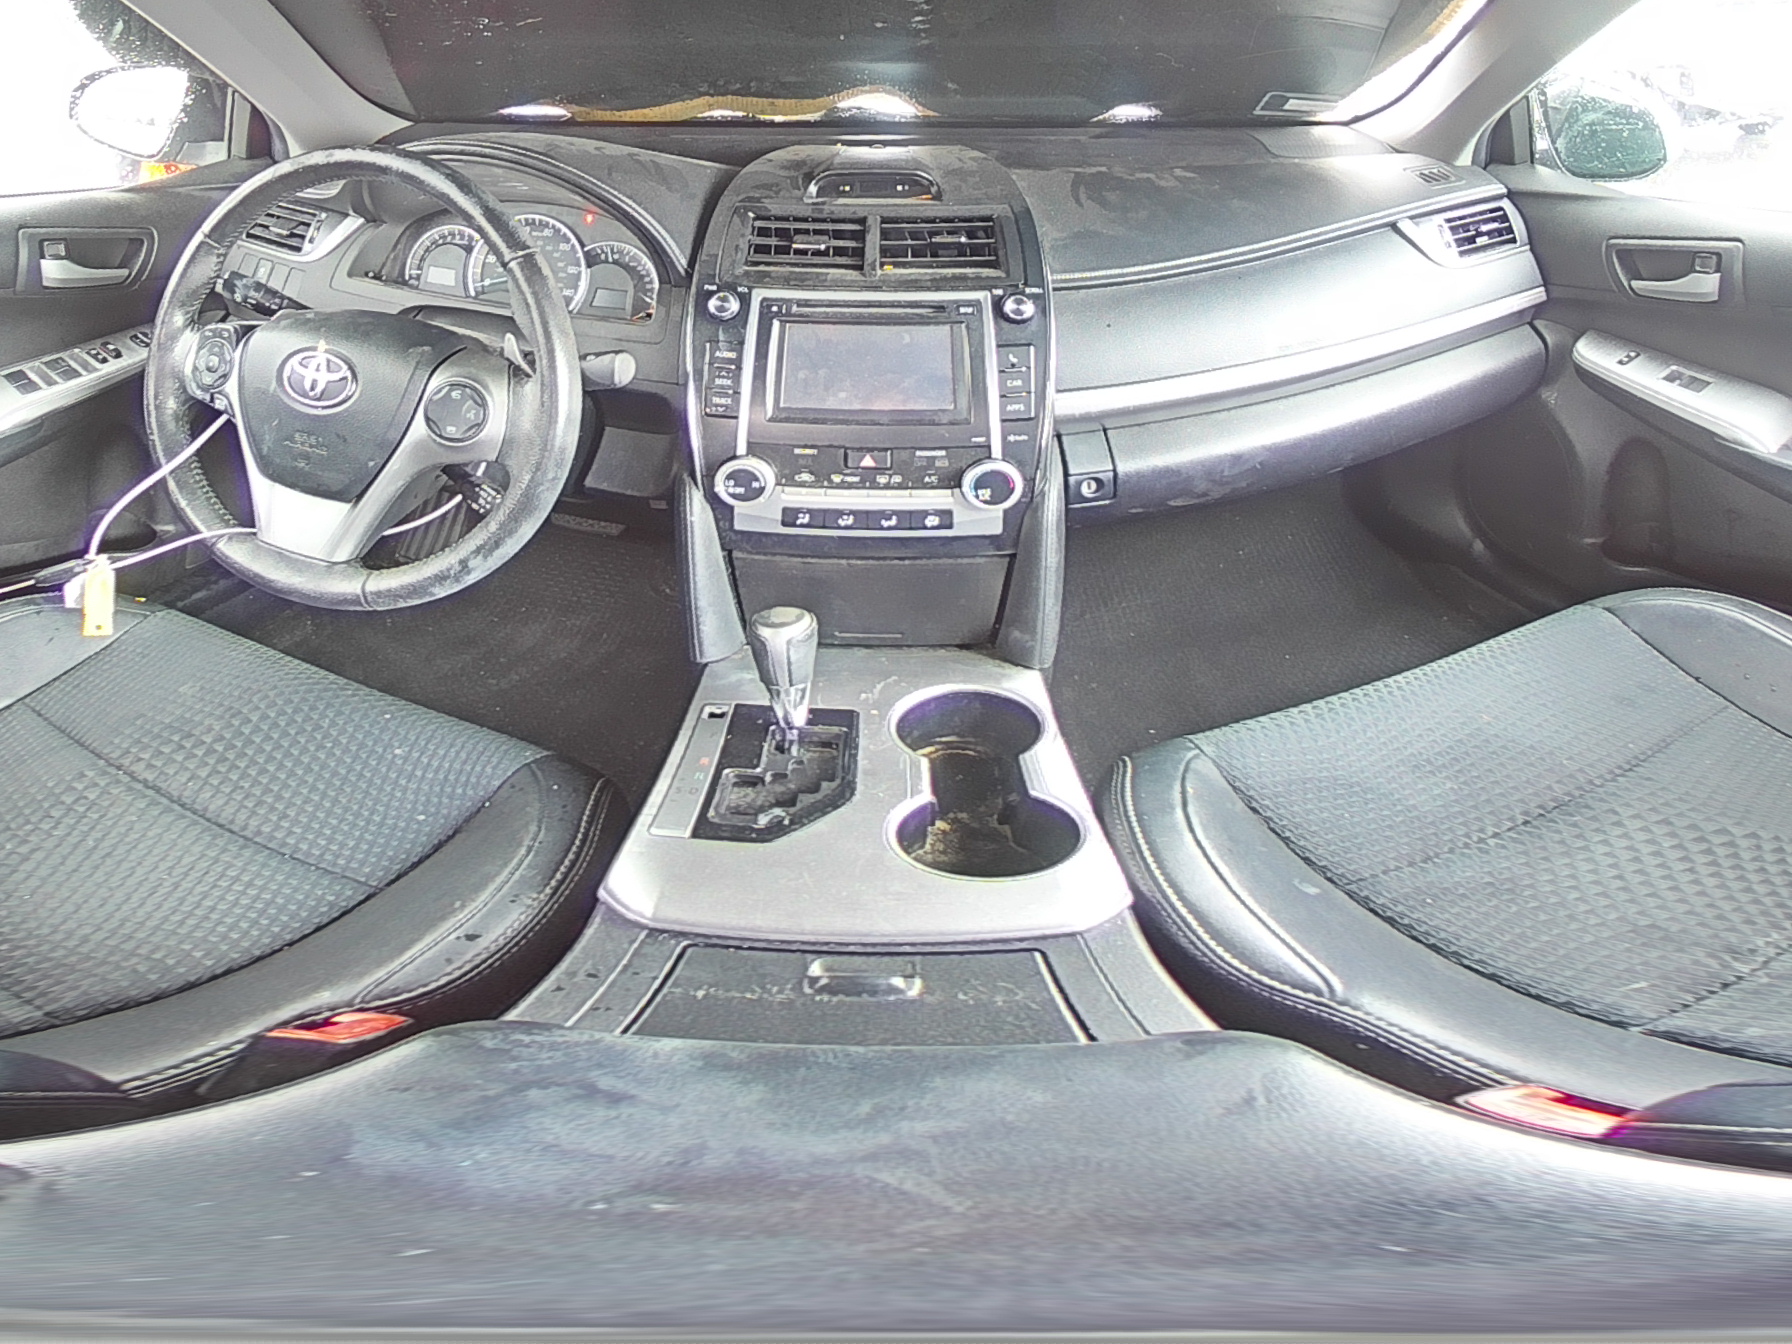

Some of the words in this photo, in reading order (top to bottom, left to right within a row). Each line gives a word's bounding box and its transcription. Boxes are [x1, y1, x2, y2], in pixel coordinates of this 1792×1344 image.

[714, 350, 737, 359] AUDIO
[1006, 379, 1023, 387] CAR
[923, 475, 939, 484] A/C
[694, 771, 705, 780] N
